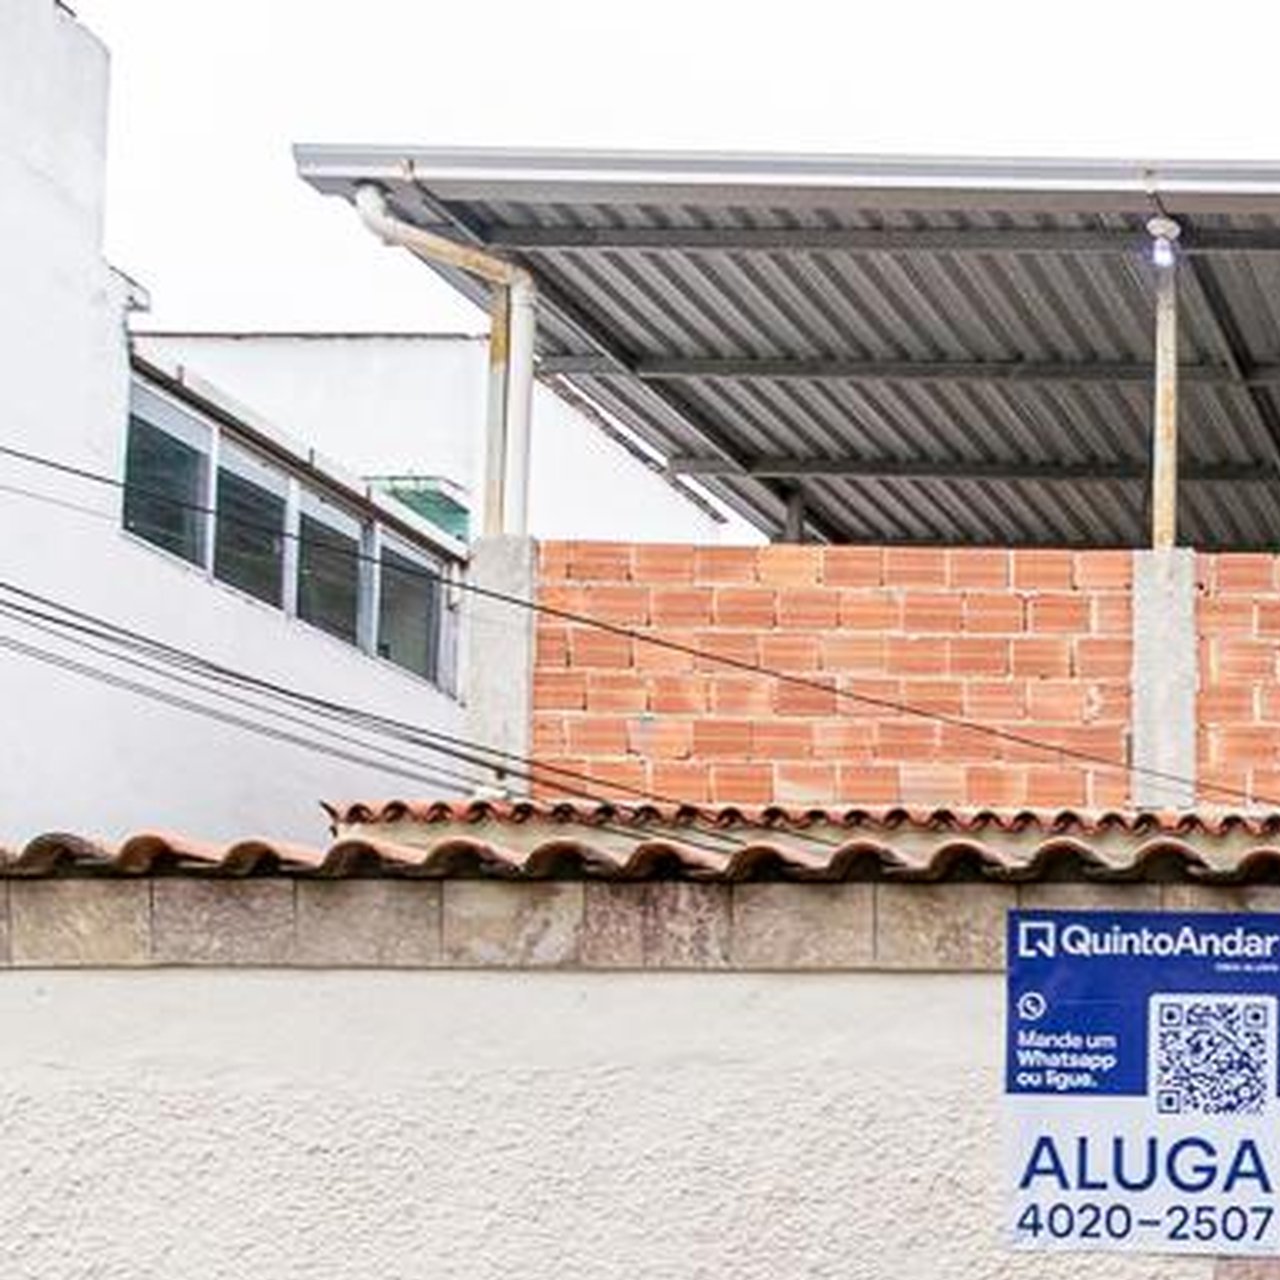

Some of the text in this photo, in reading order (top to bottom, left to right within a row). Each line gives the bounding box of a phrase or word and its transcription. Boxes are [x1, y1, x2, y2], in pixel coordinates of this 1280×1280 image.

[1061, 925, 1280, 957] QuintoAndar
[1018, 1030, 1117, 1049] Mande um
[1017, 1072, 1042, 1087] ou
[1018, 1135, 1274, 1194] ALUGA
[1017, 1202, 1274, 1241] 4020-2507
